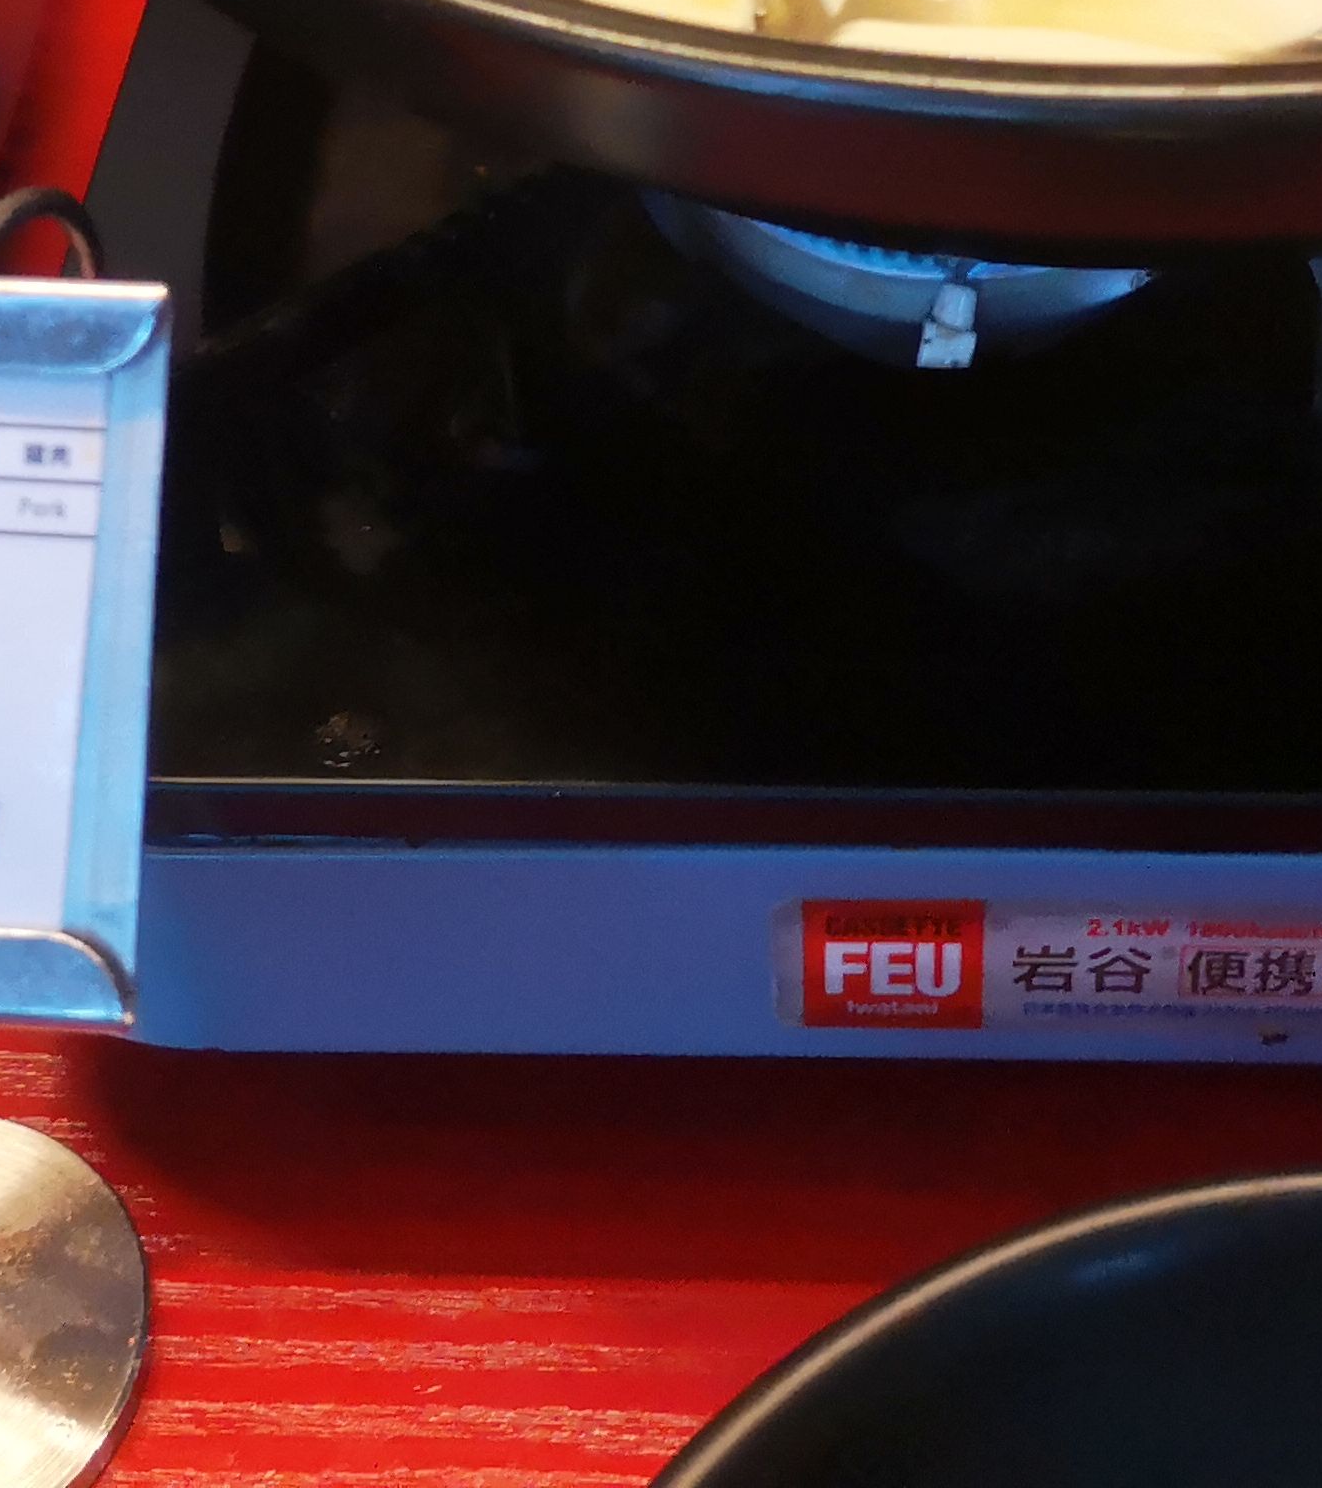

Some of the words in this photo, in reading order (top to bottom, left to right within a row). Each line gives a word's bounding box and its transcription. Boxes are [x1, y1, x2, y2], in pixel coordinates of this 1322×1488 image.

[18, 496, 67, 517] Pork
[1087, 918, 1171, 937] 2.1kW
[824, 941, 963, 998] FEU
[1012, 944, 1152, 994] 岩谷
